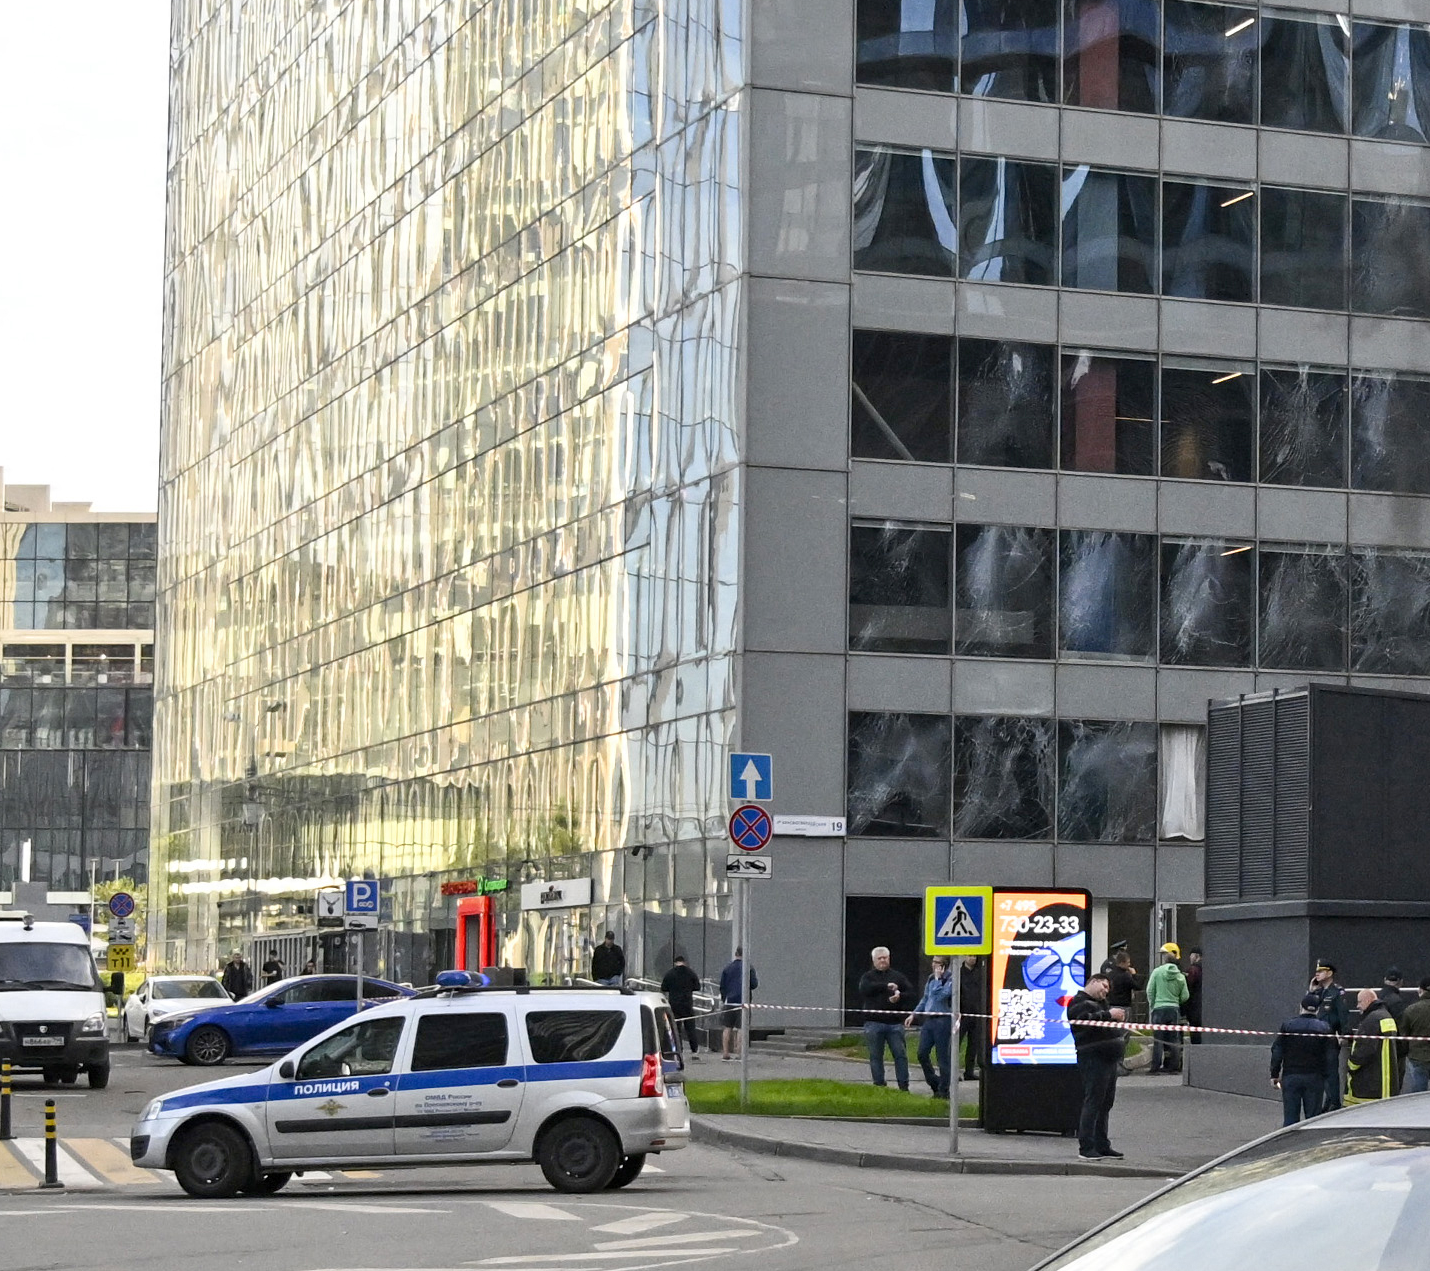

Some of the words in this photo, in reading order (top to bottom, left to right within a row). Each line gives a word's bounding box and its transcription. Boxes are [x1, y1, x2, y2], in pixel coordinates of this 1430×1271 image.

[831, 821, 843, 832] 19
[1014, 899, 1037, 911] 495
[999, 915, 1079, 933] 730-23-33
[293, 1080, 360, 1096] ПОЛИЦИЯ
